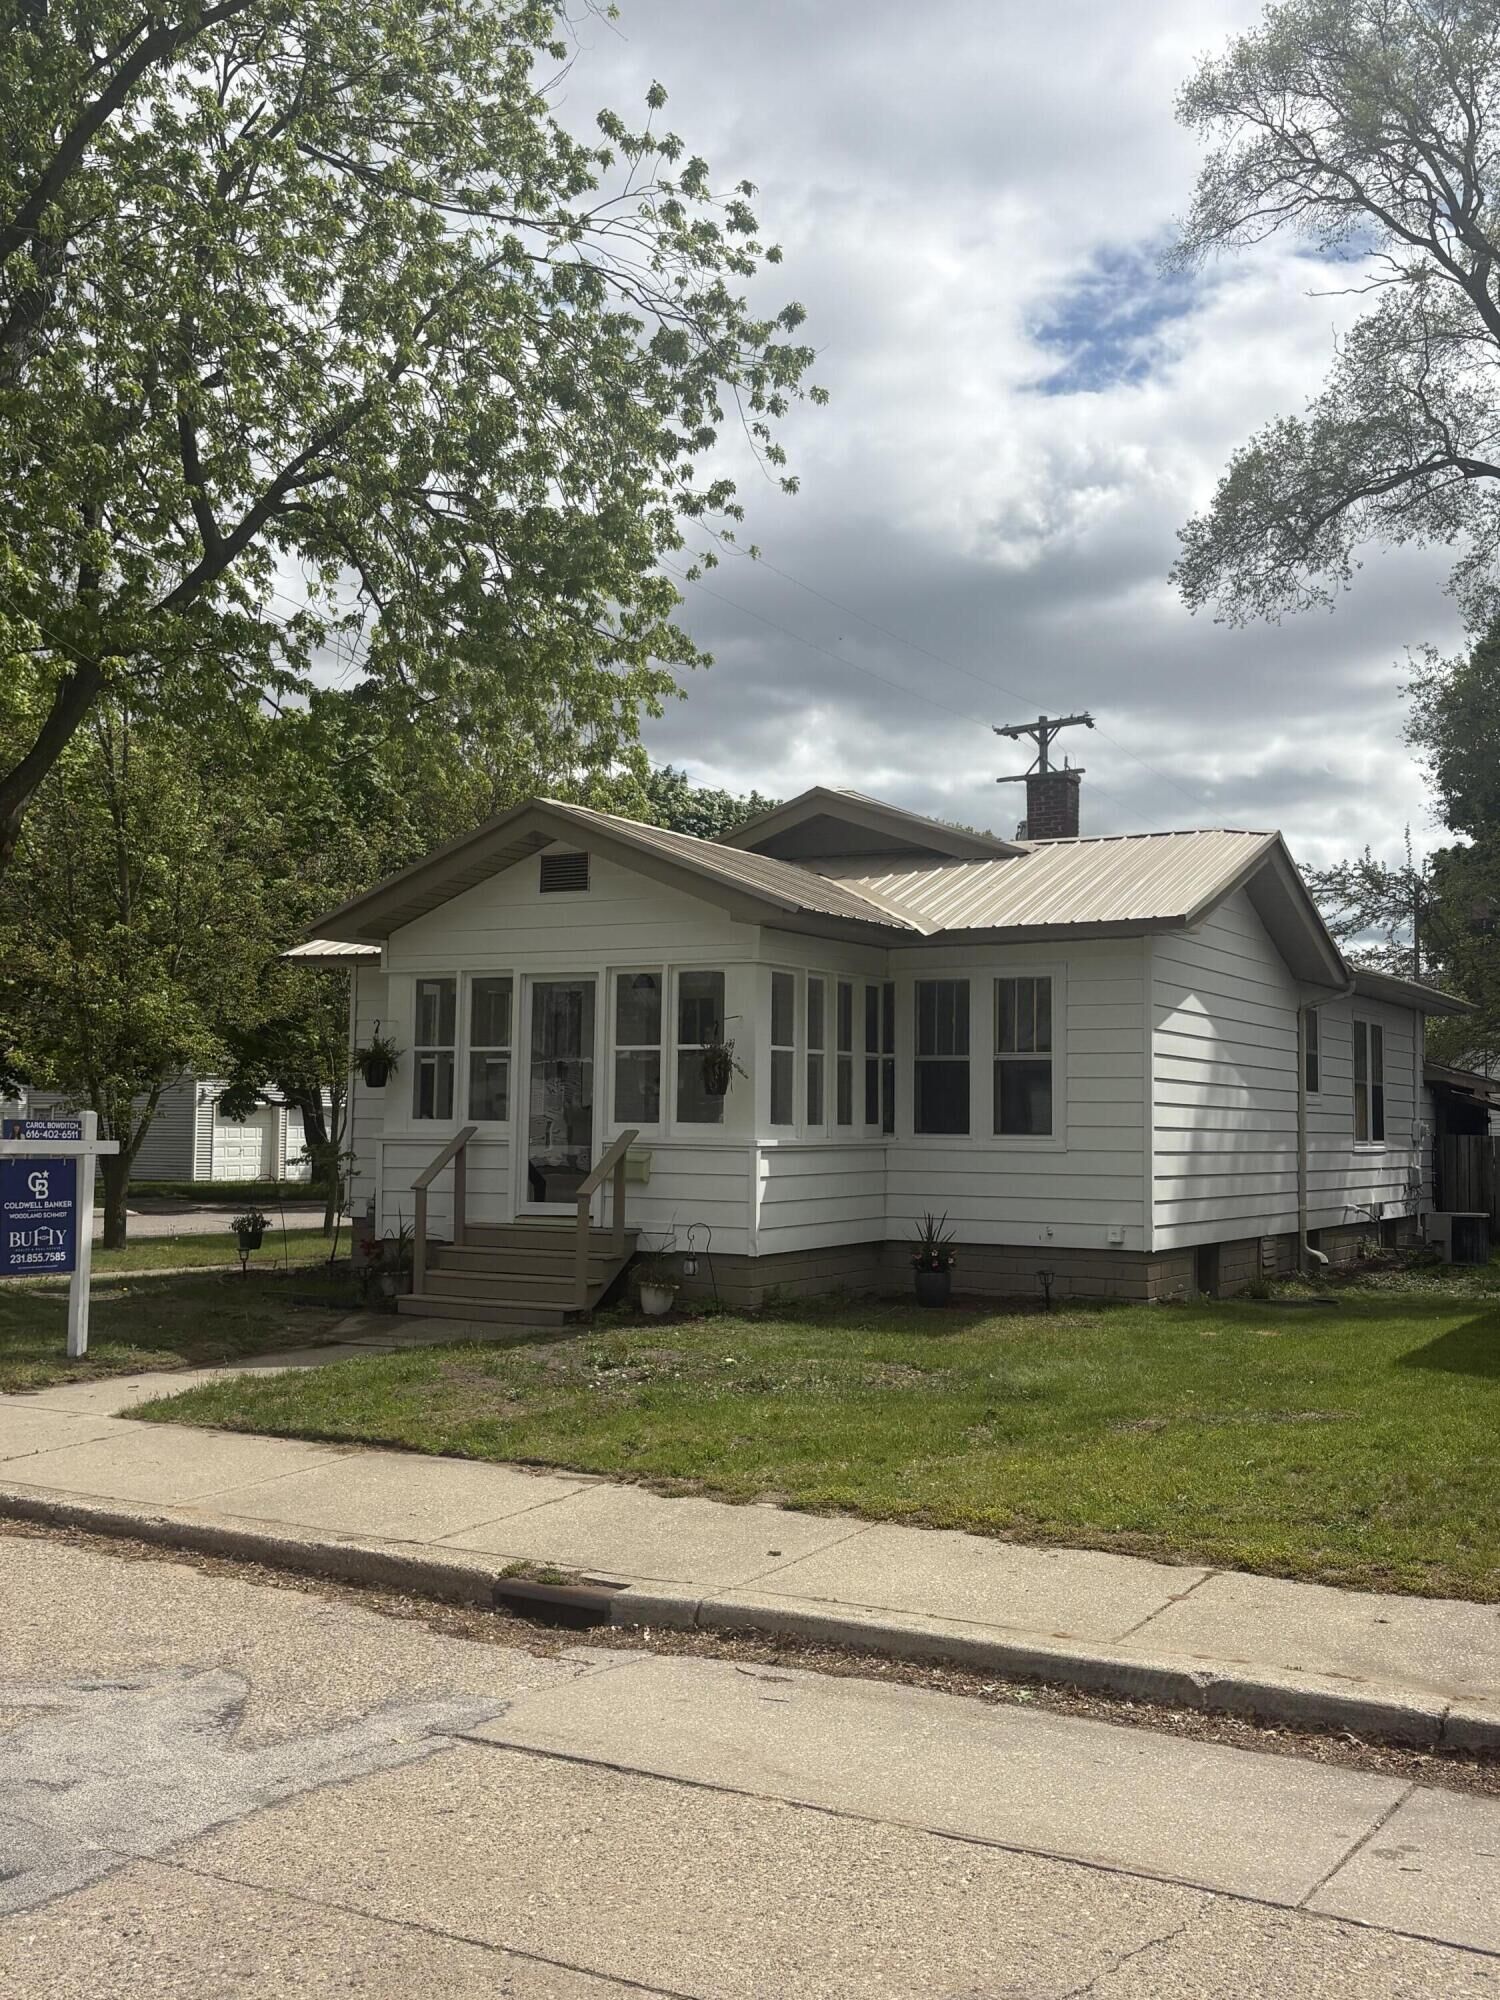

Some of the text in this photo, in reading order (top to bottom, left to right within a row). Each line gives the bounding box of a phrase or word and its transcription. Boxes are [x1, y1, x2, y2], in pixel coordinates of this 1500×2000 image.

[26, 1130, 78, 1138] 616-402-6511
[4, 1201, 43, 1210] COLDWELL
[10, 1252, 66, 1264] 231.855.7585
